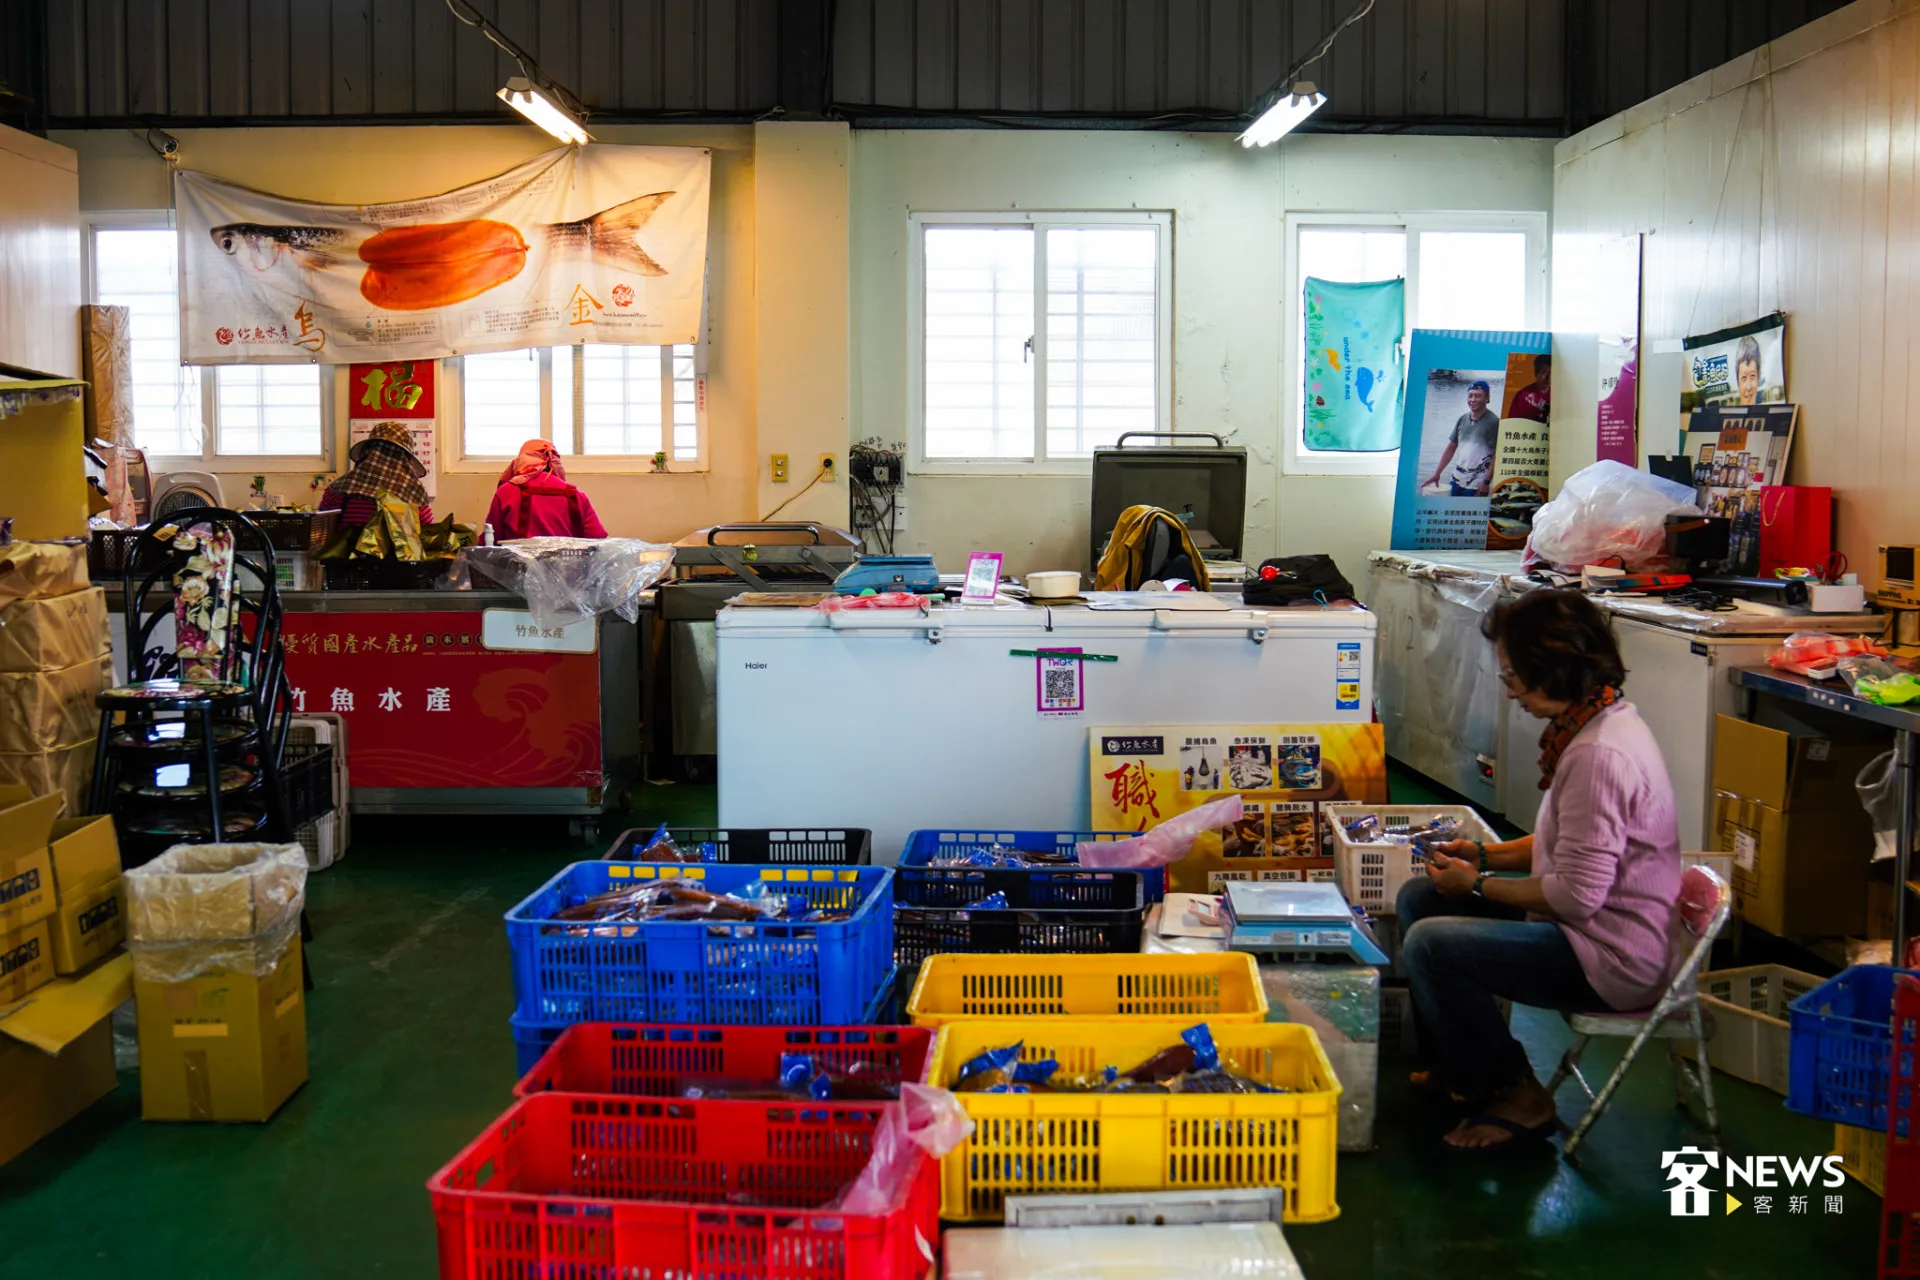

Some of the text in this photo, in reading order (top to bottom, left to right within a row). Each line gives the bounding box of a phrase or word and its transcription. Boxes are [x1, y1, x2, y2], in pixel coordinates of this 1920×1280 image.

[564, 284, 604, 326] 金
[237, 325, 290, 340] 竹魚水產
[292, 300, 326, 352] 烏
[1343, 336, 1351, 363] under
[1344, 365, 1352, 381] the
[361, 363, 423, 410] 福
[1505, 431, 1537, 441] 竹魚水產
[515, 624, 565, 639] 竹魚水產
[280, 632, 418, 655] 優質國產水產品
[745, 661, 768, 669] Haier
[291, 686, 452, 712] 竹魚水產
[1104, 759, 1160, 832] 職
[1263, 871, 1296, 880] 真空包裝
